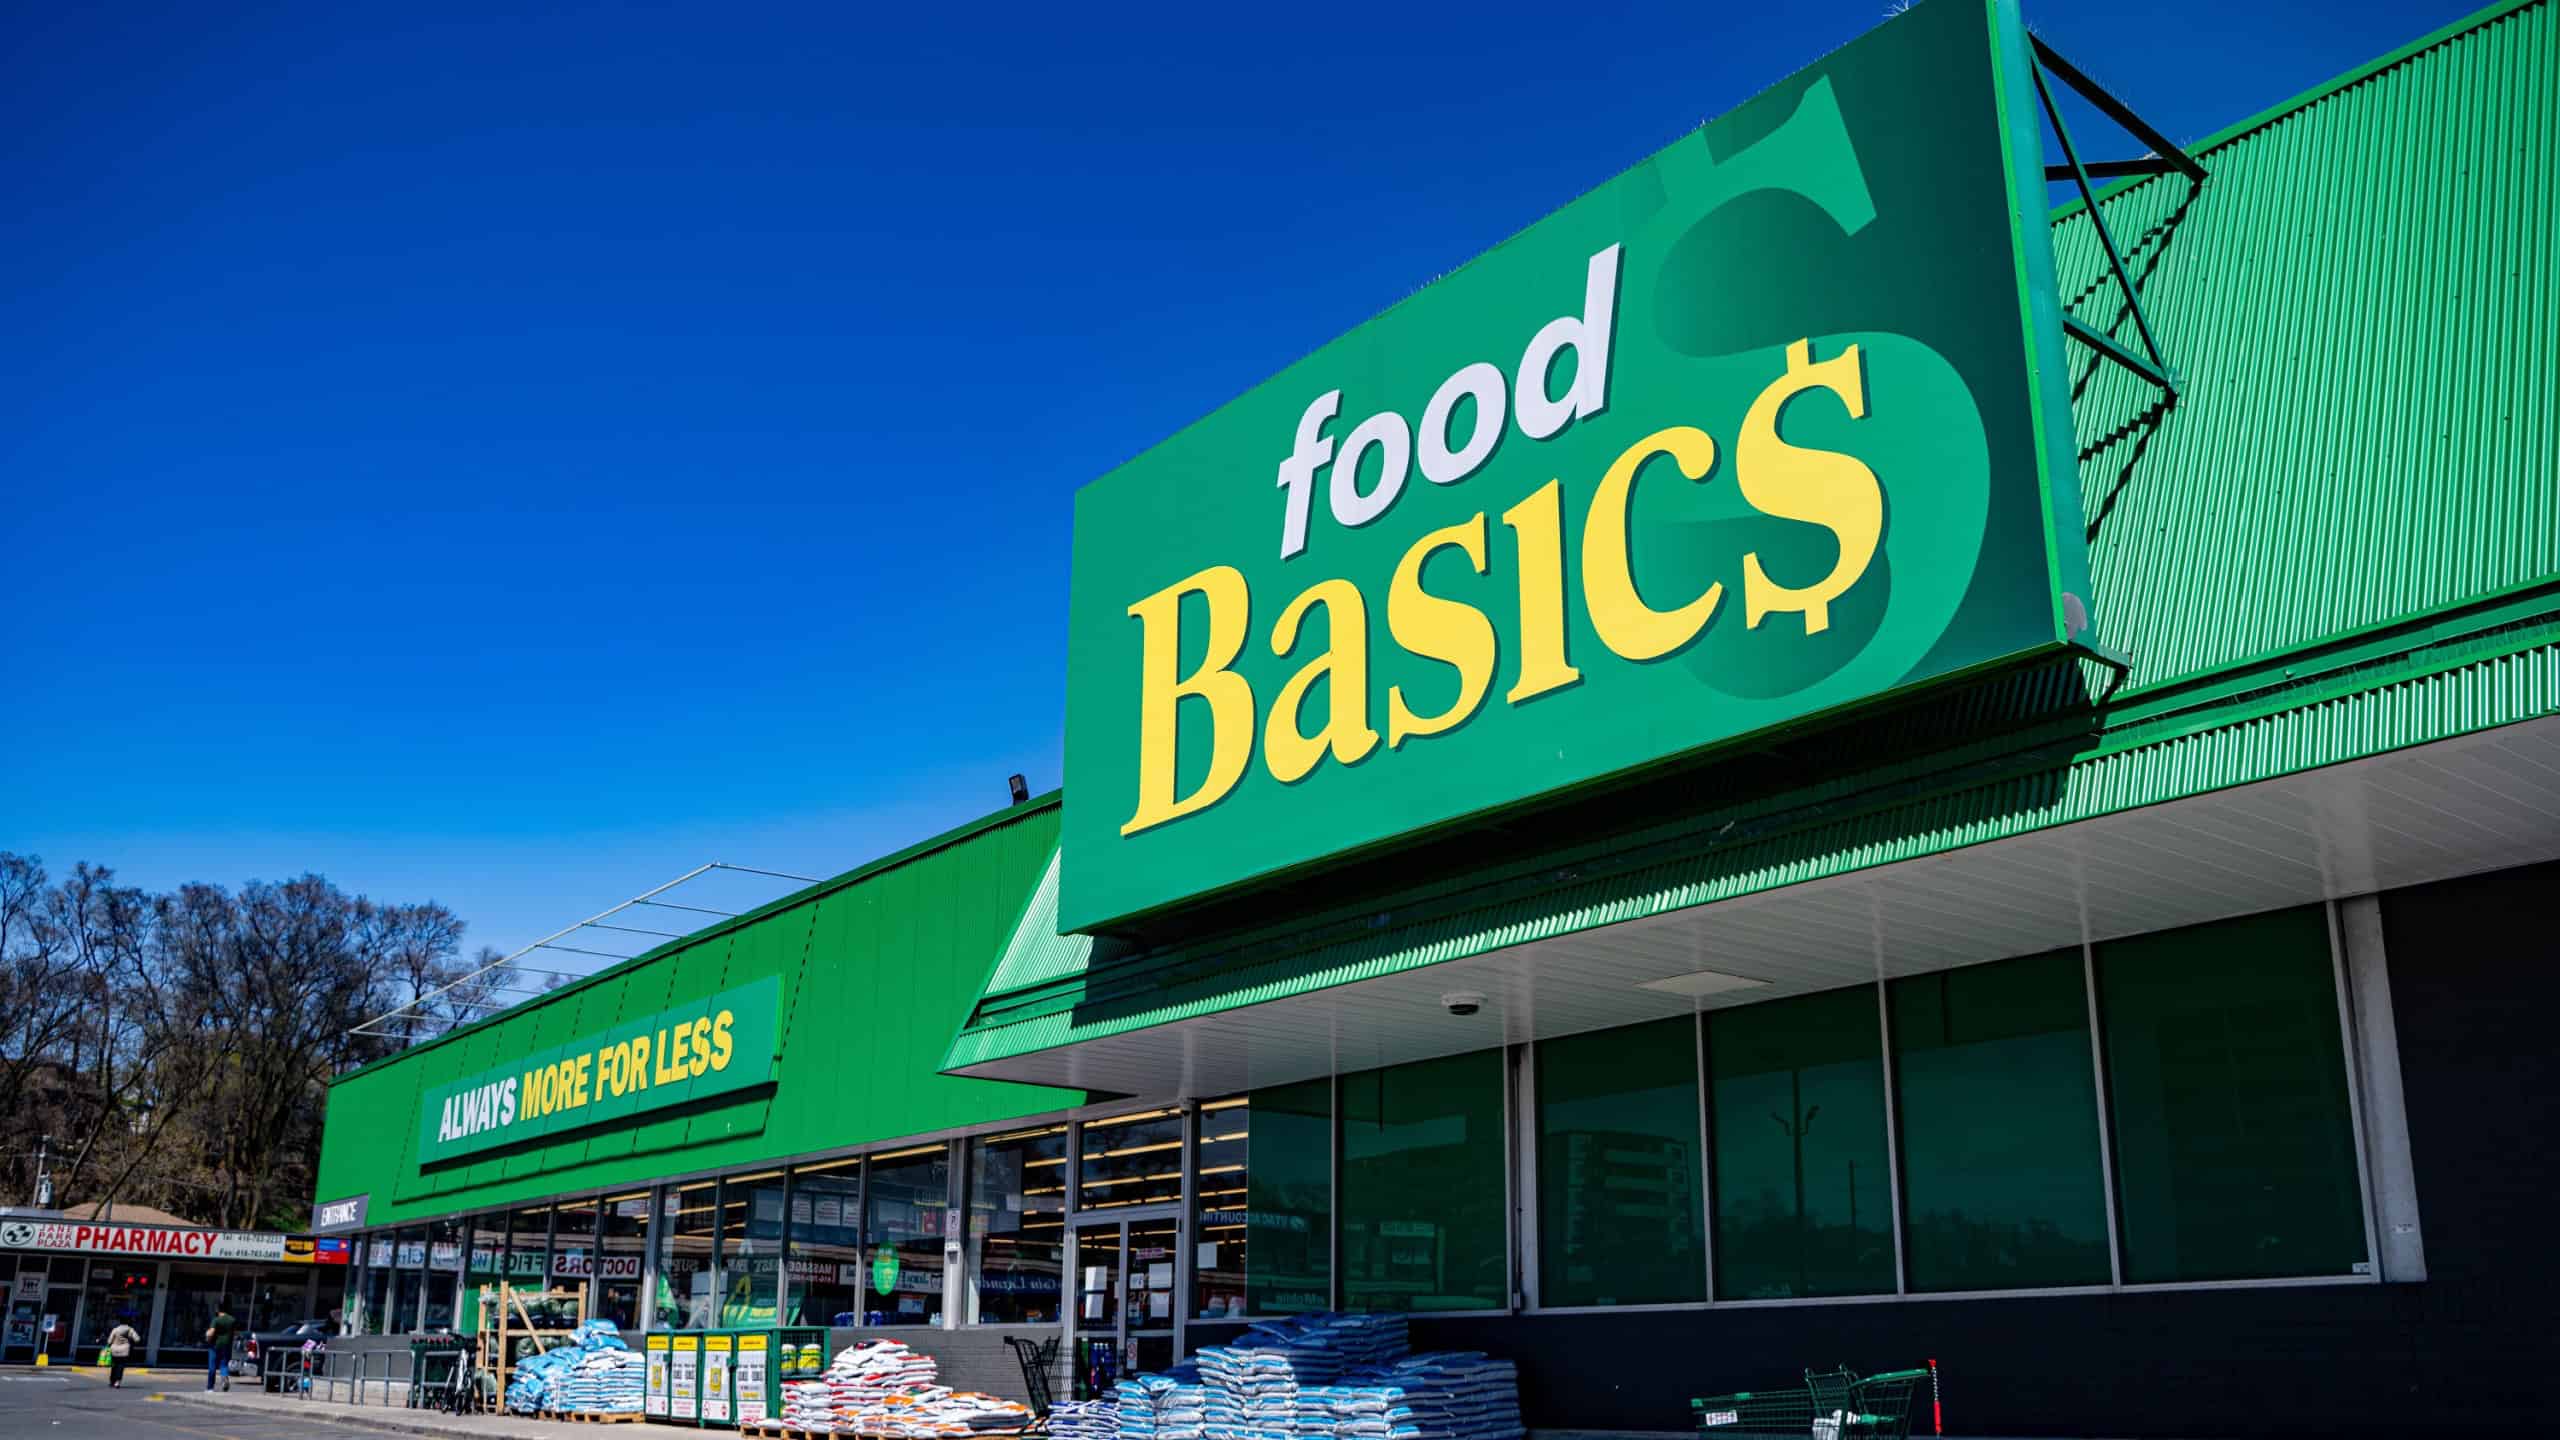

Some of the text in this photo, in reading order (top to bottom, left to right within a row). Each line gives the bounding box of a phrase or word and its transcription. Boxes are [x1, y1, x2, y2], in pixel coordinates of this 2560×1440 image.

[1276, 241, 1621, 560] food
[437, 1009, 735, 1143] ALWAYS MORE FOR LESS
[320, 1201, 358, 1227] ENTRANCE
[38, 1231, 73, 1241] PARK
[40, 1223, 73, 1233] JANE
[75, 1225, 219, 1256] PHARMACY
[37, 1240, 72, 1249] PLAZA
